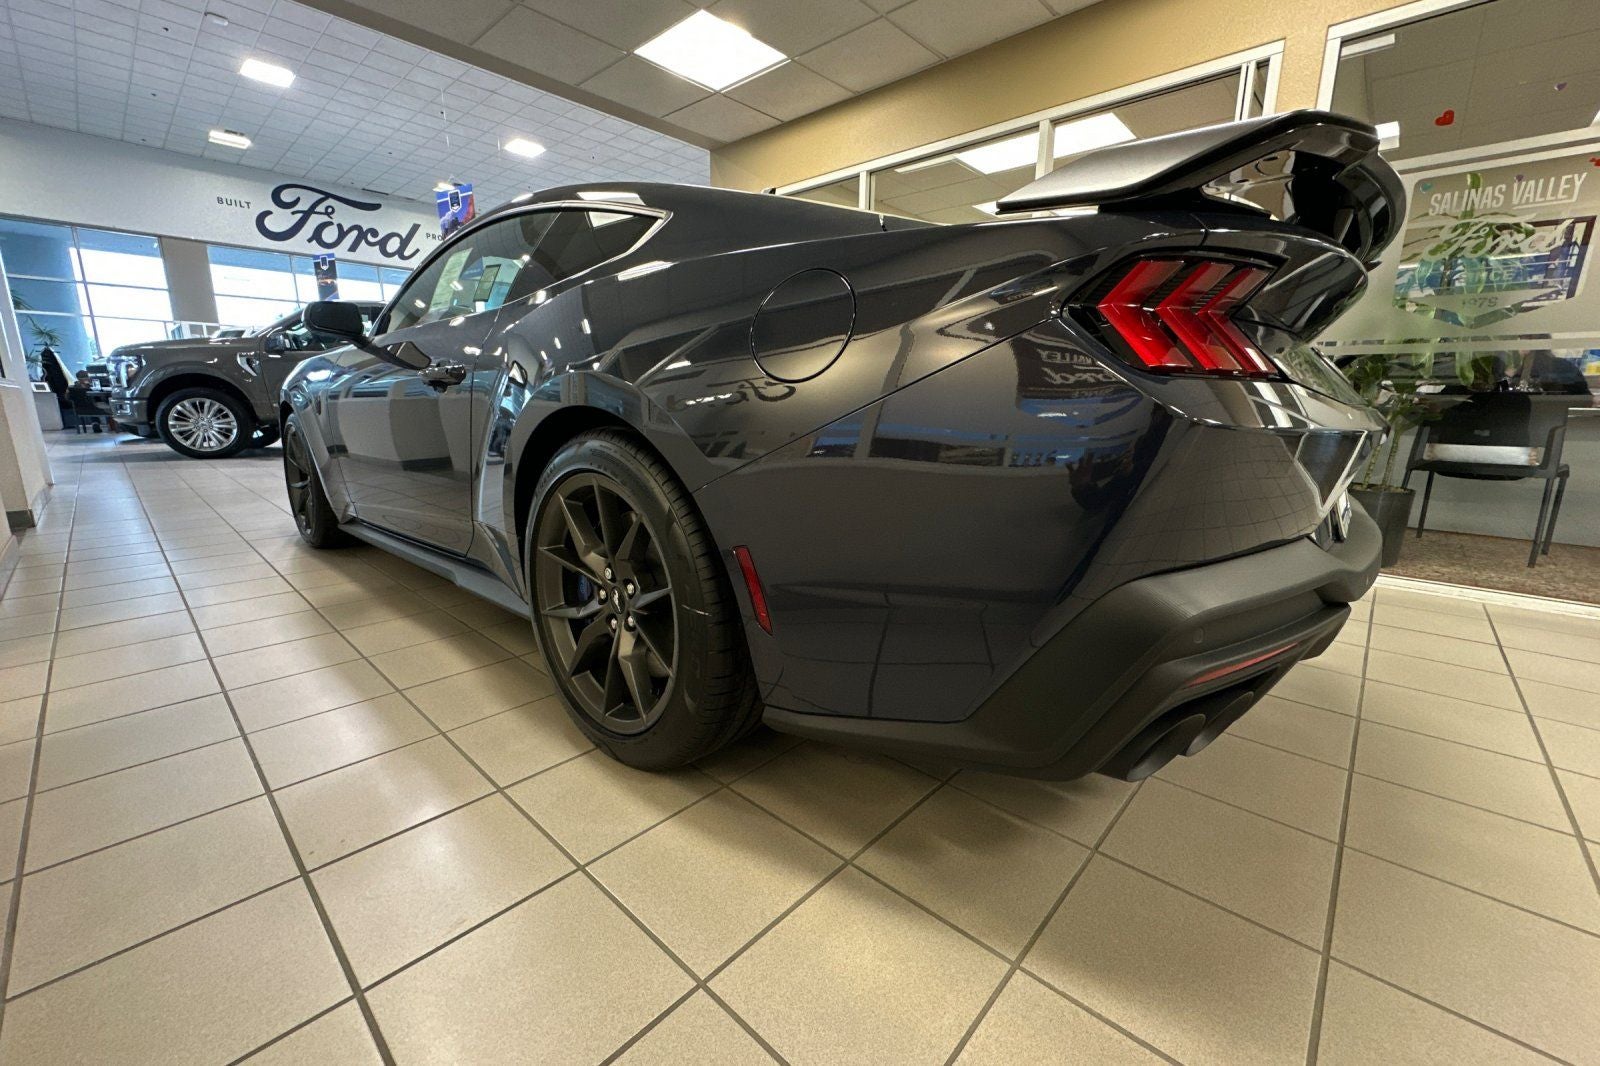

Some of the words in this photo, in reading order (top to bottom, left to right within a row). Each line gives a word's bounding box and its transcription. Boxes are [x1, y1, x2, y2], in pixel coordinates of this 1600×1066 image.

[1428, 183, 1507, 216] SALINAS
[1512, 172, 1588, 209] VALLEY
[216, 195, 251, 210] BUILT
[255, 183, 421, 261] Ford
[425, 232, 443, 242] PRO
[1423, 212, 1576, 260] Ford
